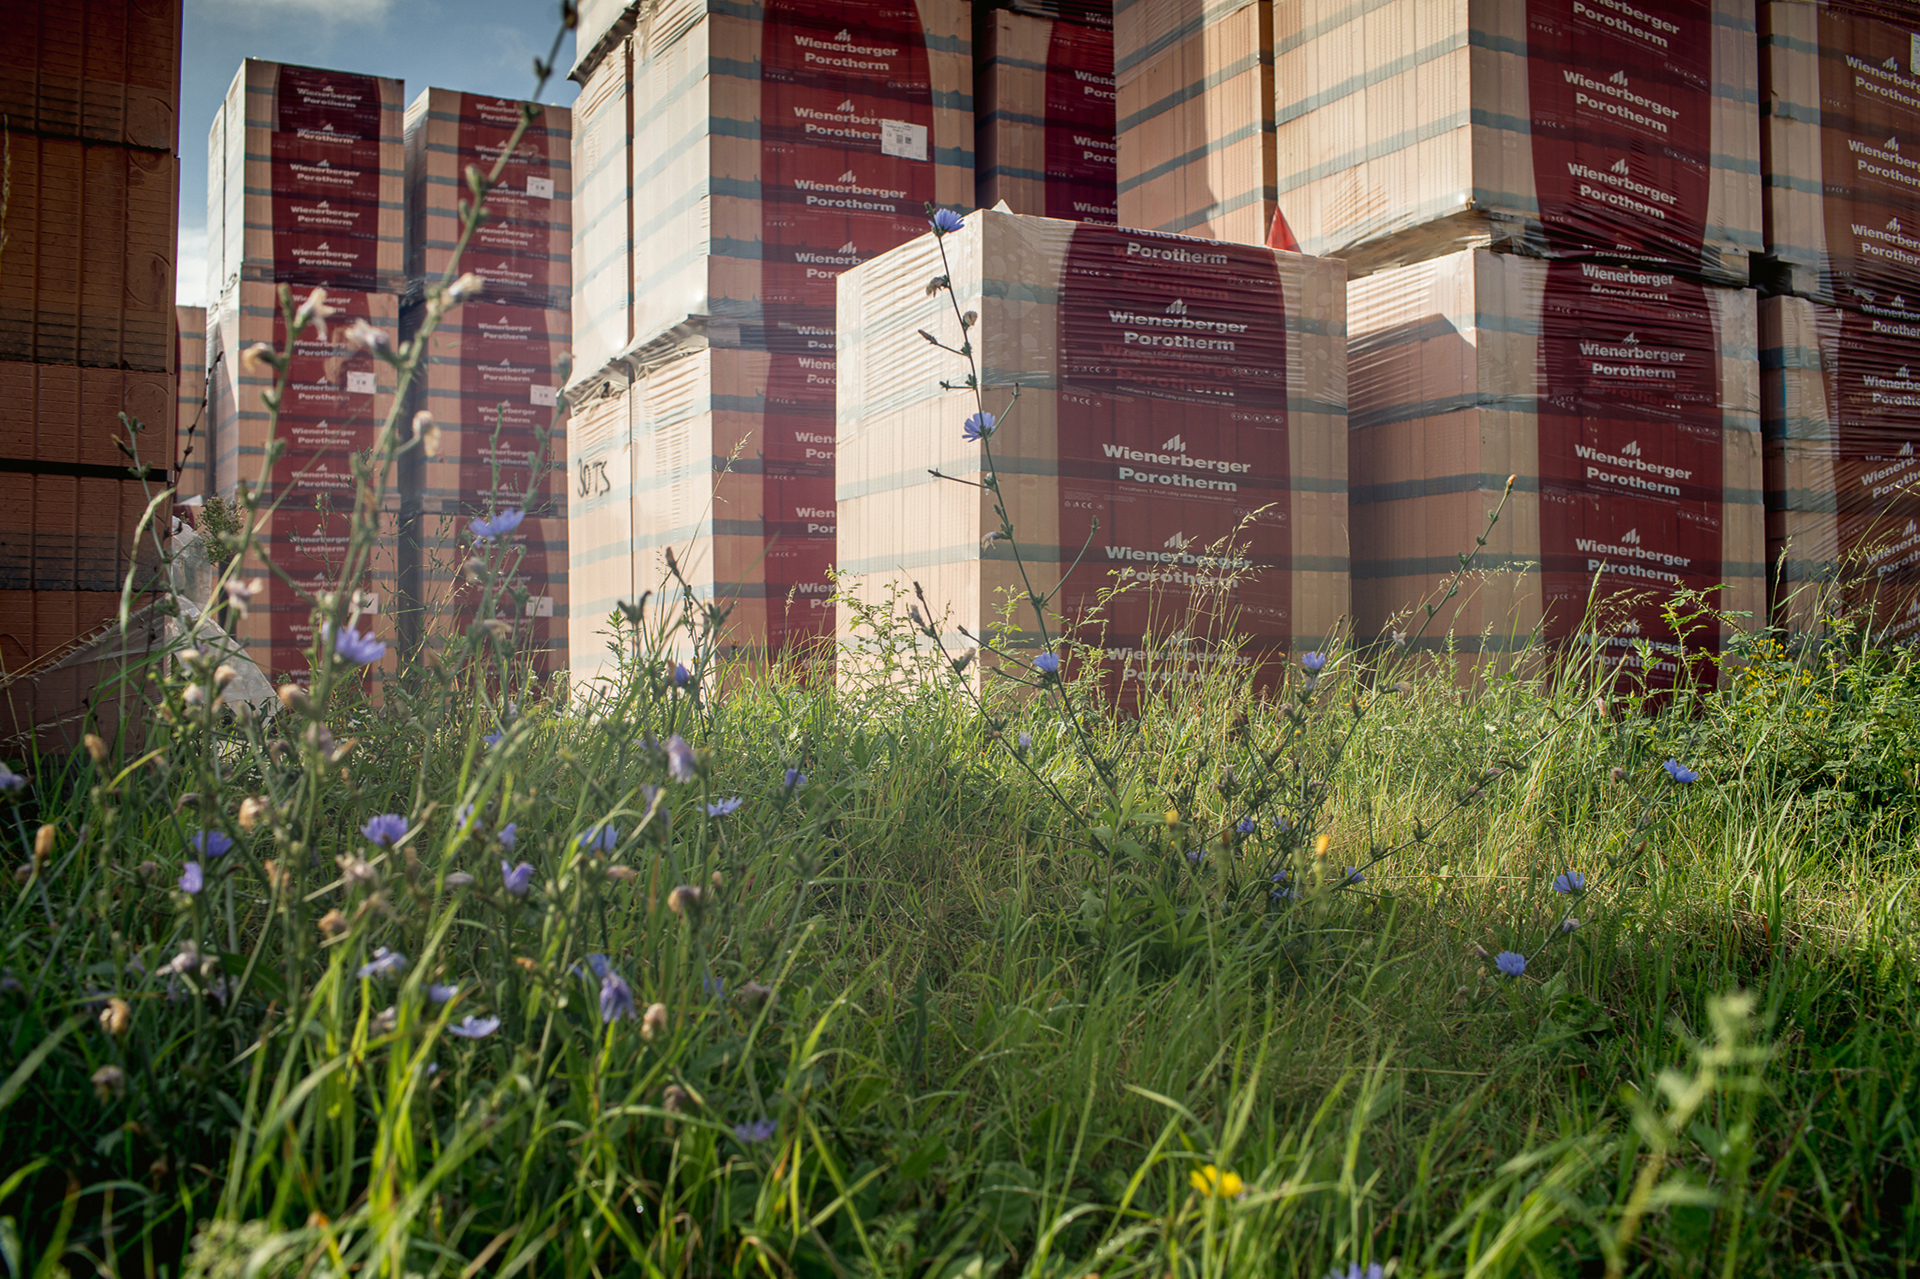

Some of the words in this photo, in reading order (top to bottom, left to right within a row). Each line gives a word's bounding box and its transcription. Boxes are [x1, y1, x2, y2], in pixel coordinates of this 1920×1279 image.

[1573, 1, 1668, 48] Porotherm
[1592, 0, 1680, 34] nerberger
[794, 35, 898, 57] Wienerberger
[805, 52, 889, 70] Porotherm
[297, 88, 362, 101] Wienerberger
[303, 97, 356, 108] Porotherm
[1563, 70, 1680, 119] Wienerberger
[1576, 92, 1668, 133] Porotherm
[297, 132, 354, 145] Porotherm
[290, 163, 360, 178] Wienerberger
[297, 174, 354, 185] Porotherm
[794, 179, 906, 199] Wienerberger
[1567, 162, 1677, 205] Wienerberger
[806, 196, 896, 212] Porotherm
[1580, 184, 1665, 220] Porotherm
[290, 206, 360, 219] Wienerberger
[297, 215, 353, 226] Porotherm
[480, 236, 528, 246] Porotherm
[1851, 223, 1920, 251] Wienerber
[292, 249, 359, 261] Wienerberger
[298, 257, 352, 268] Porotherm
[1127, 242, 1228, 265] Porotherm
[475, 267, 533, 279] Wienerberger
[1581, 262, 1674, 287] Wienerberger
[478, 322, 532, 332] Wienerberger
[1108, 310, 1248, 334] Wienerberger
[483, 332, 528, 341] Porotherm
[1124, 331, 1235, 351] Porotherm
[1579, 343, 1685, 362] Wienerberger
[477, 364, 536, 374] Wienerberger
[483, 374, 530, 383] Porotherm
[1592, 362, 1676, 379] Porotherm
[291, 427, 356, 437] Wienerberger
[298, 436, 350, 445] Porotherm
[1102, 443, 1251, 474] Wienerberger
[1574, 444, 1692, 480] Wienerberger
[1119, 466, 1237, 492] Porotherm
[1587, 466, 1680, 496] Porotherm
[1105, 545, 1253, 570] Wienerberger
[1575, 538, 1690, 567] Wienerberger
[1121, 568, 1238, 588] Porotherm
[1588, 559, 1679, 583] Porotherm
